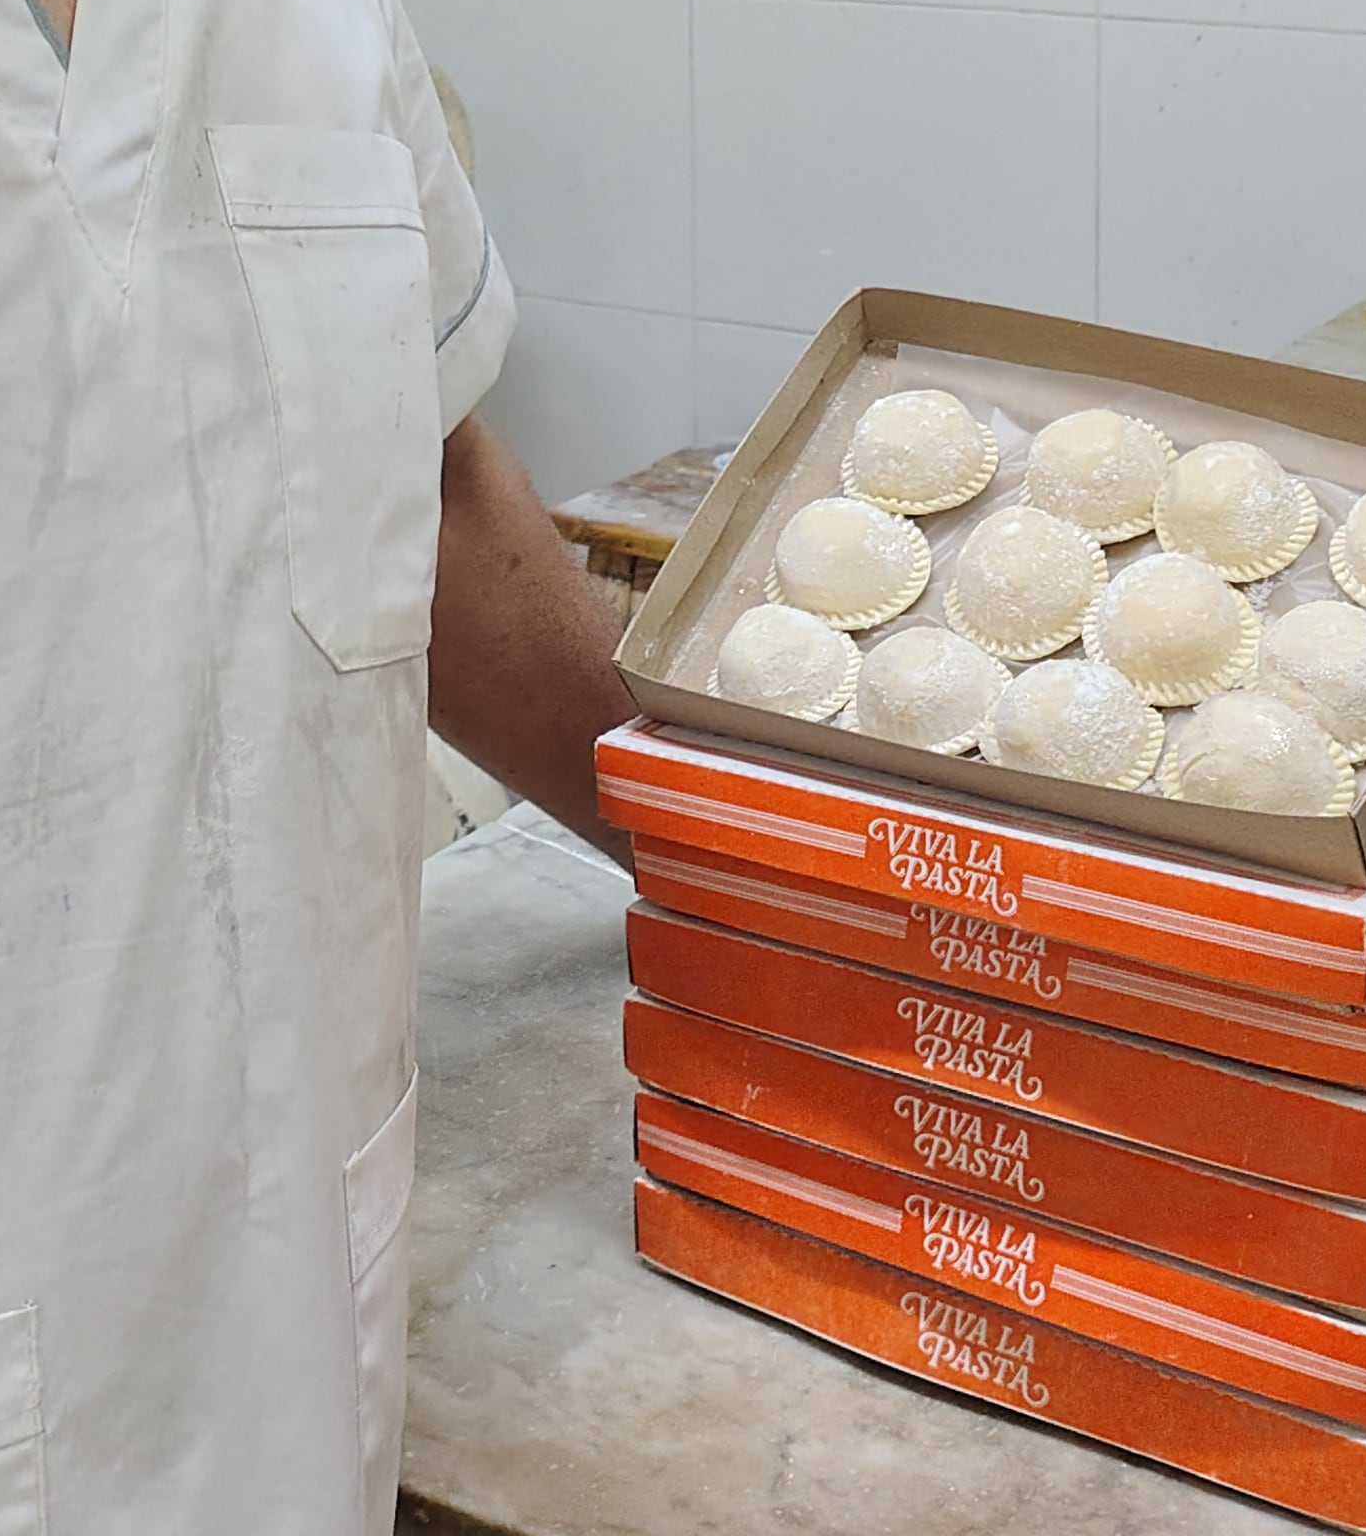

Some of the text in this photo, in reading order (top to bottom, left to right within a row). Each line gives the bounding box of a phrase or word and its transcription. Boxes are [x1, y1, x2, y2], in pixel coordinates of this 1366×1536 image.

[868, 817, 1004, 875] VIVA LA
[890, 854, 1018, 917] PASTA
[910, 904, 1047, 957] VIVA LA
[930, 936, 1061, 1000] PASTA
[897, 997, 1033, 1058] VIVA LA
[914, 1034, 1043, 1101] PASTA
[894, 1095, 1030, 1159] VIVA LA
[914, 1133, 1045, 1202] PASTA
[904, 1194, 1036, 1263] VIVA LA
[923, 1232, 1046, 1306] PASTA
[900, 1291, 1035, 1364] VIVA LA
[918, 1331, 1050, 1408] PASTA
